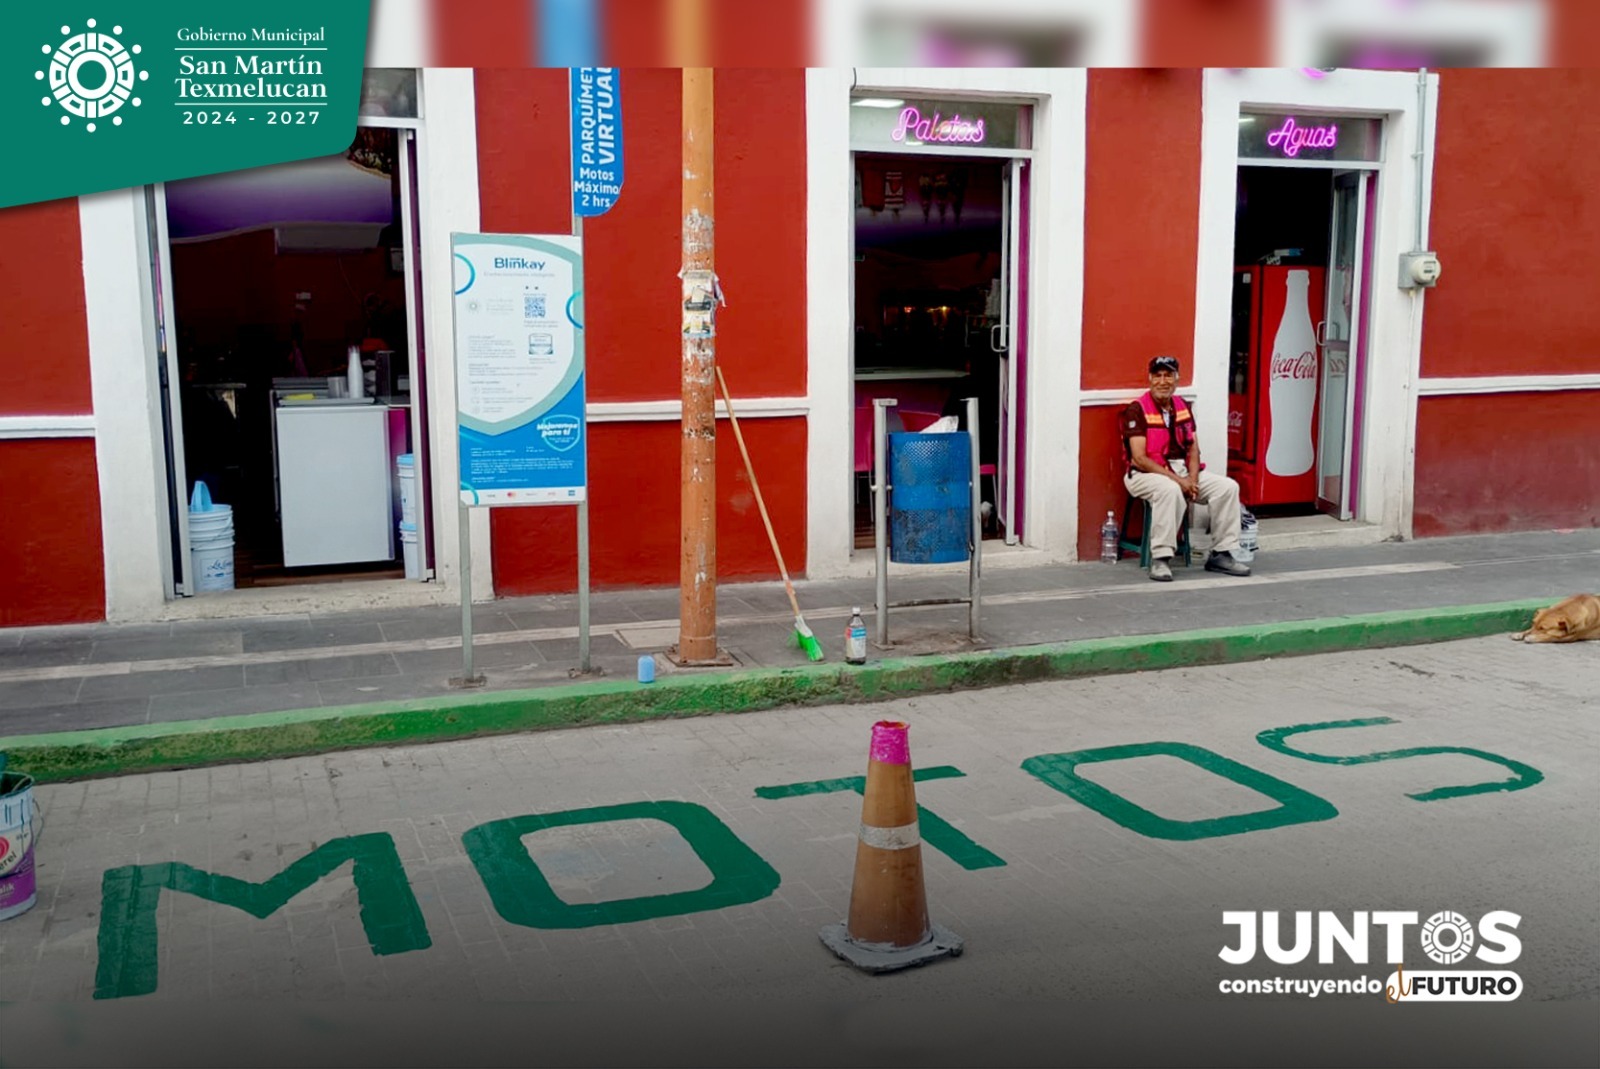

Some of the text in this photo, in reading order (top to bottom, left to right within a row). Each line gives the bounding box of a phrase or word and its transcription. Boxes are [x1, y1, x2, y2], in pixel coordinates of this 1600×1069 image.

[892, 107, 985, 142] Paletas
[1267, 118, 1338, 156] Aguas
[580, 168, 615, 181] Motos
[574, 180, 620, 195] Máximo
[582, 195, 610, 207] 2 hrs
[494, 257, 546, 270] Blinkay
[93, 717, 1544, 1000] MOTOS
